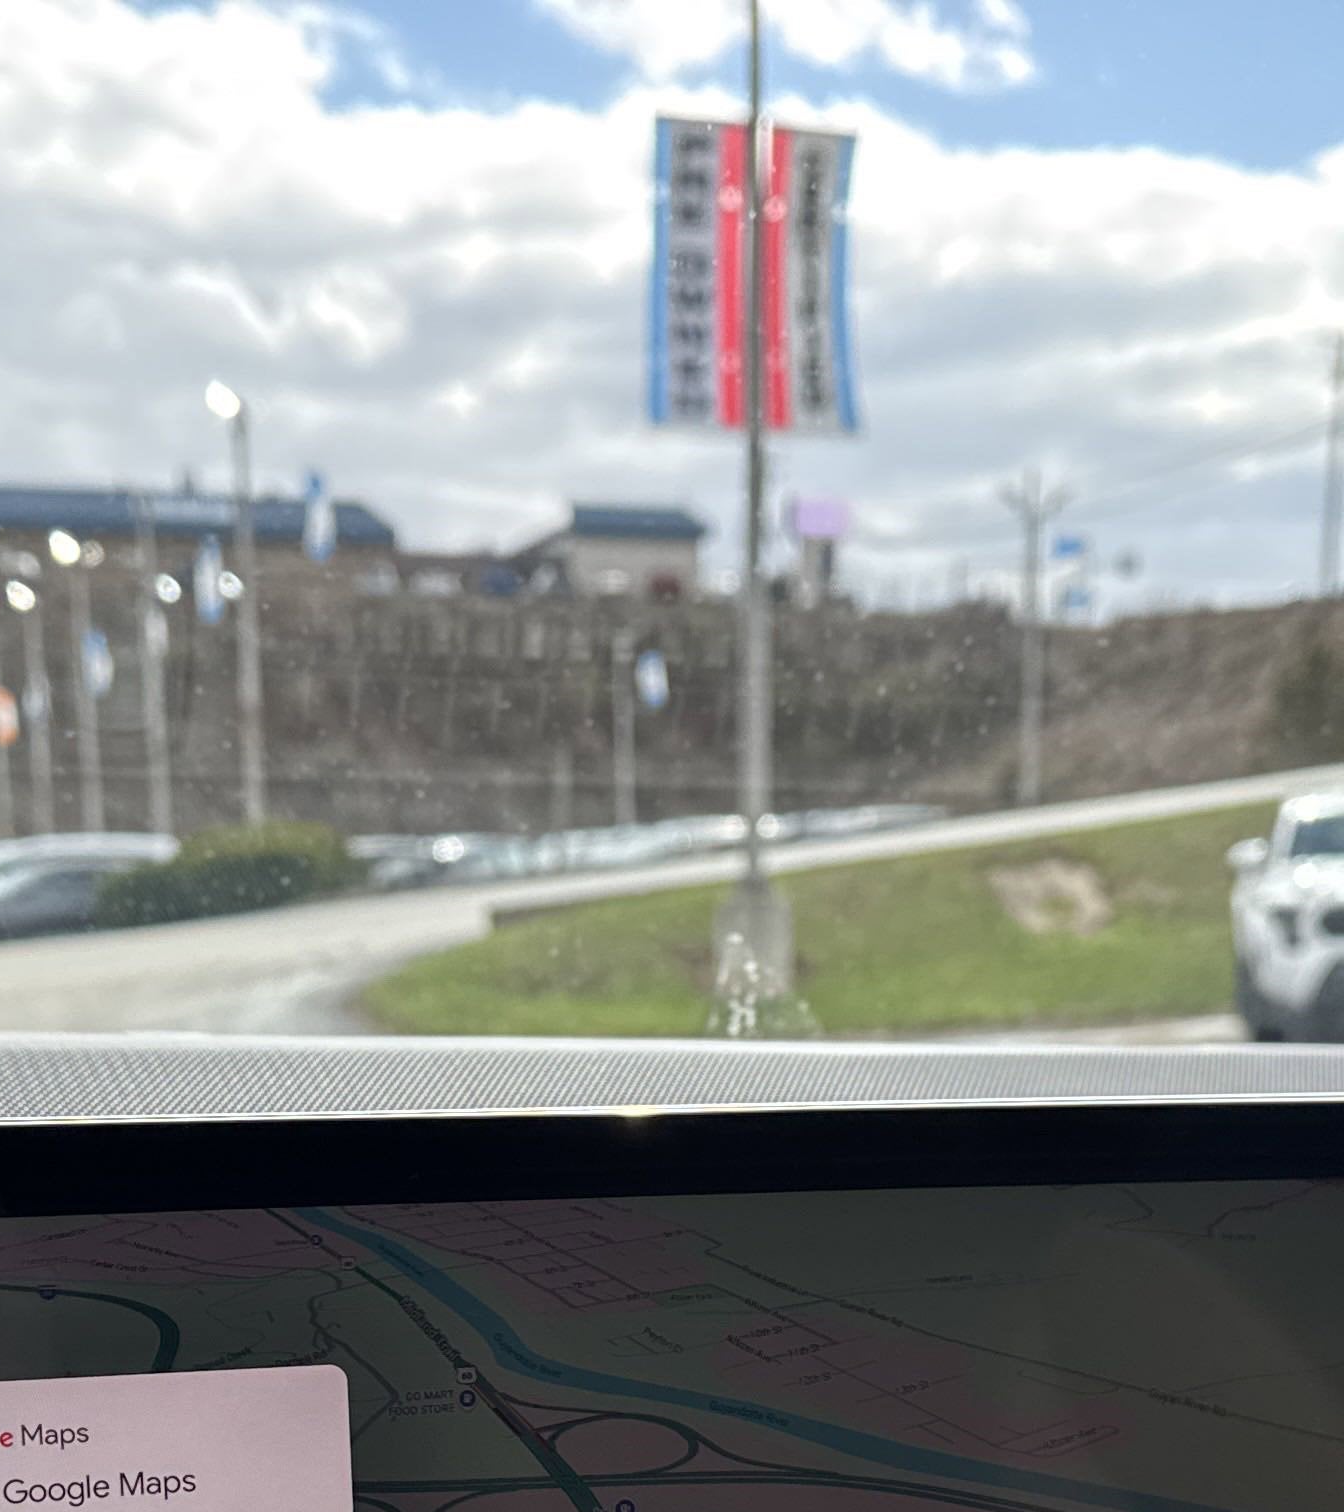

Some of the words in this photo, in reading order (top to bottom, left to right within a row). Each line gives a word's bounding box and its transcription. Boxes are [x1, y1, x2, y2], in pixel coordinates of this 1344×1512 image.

[21, 1424, 89, 1449] Maps
[3, 1475, 109, 1506] Google
[120, 1472, 196, 1500] Maps
